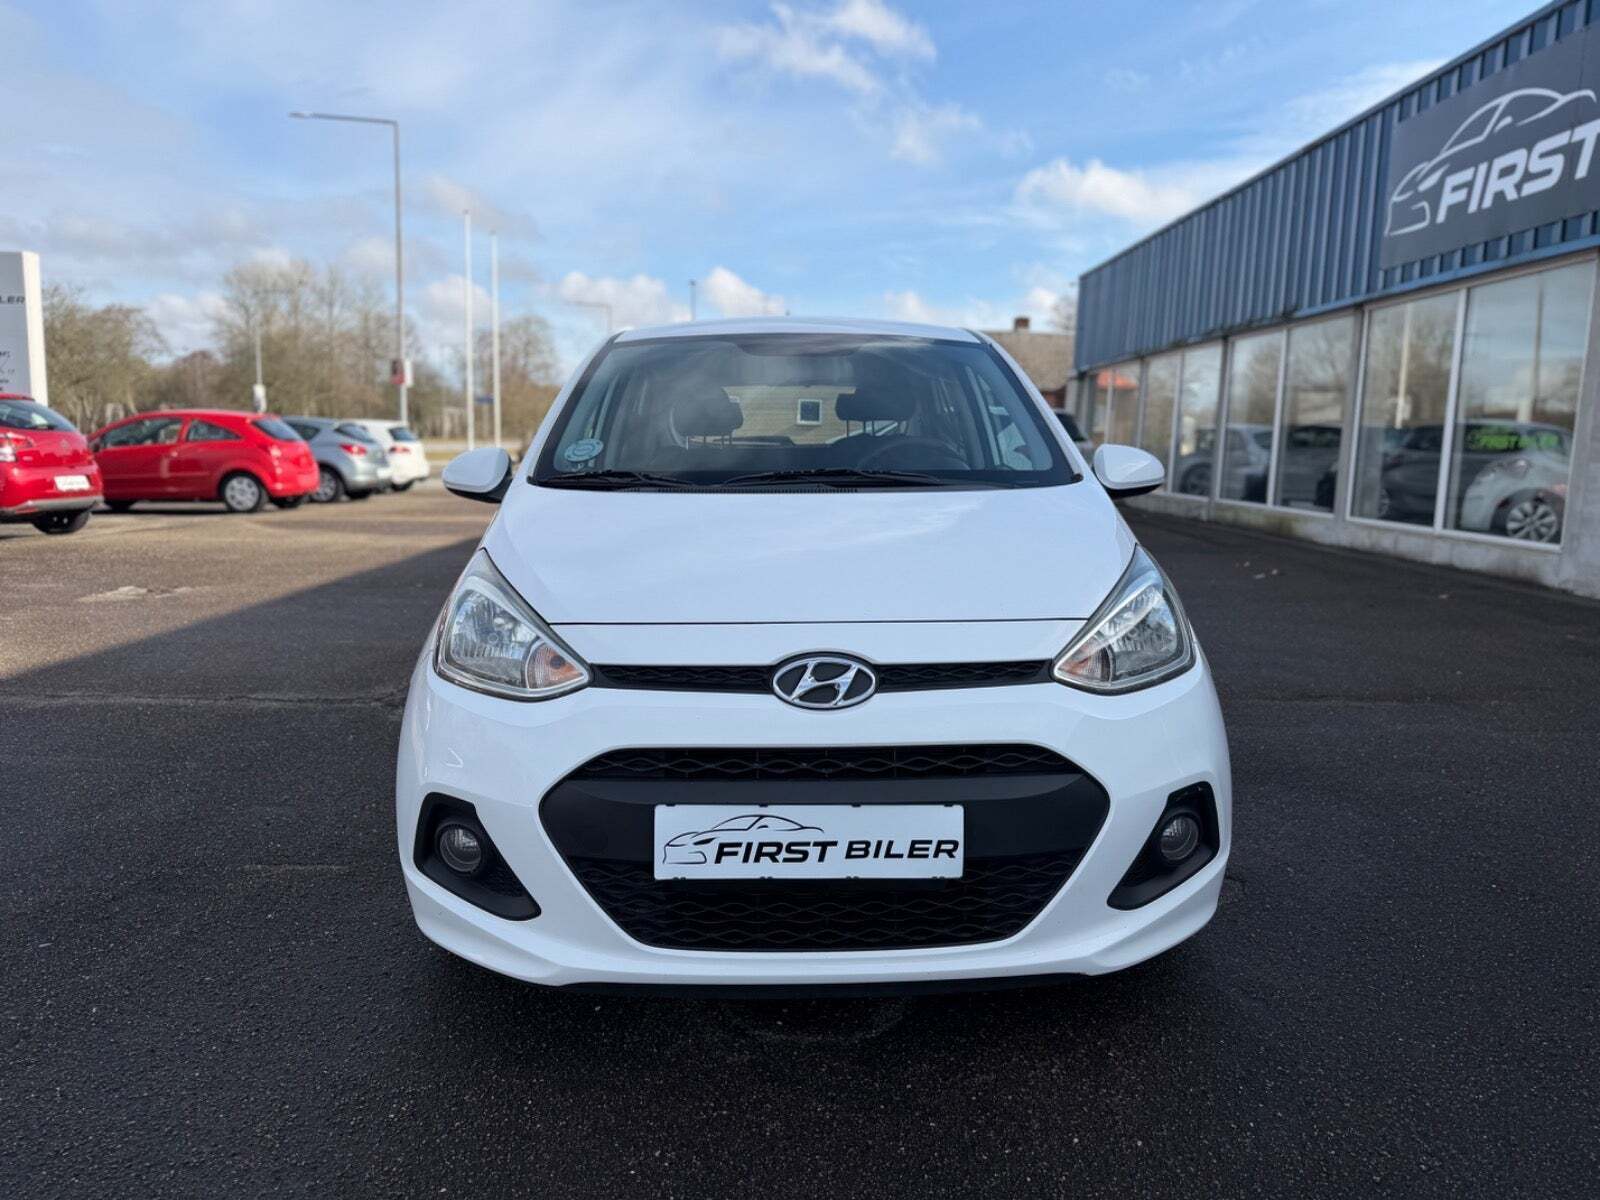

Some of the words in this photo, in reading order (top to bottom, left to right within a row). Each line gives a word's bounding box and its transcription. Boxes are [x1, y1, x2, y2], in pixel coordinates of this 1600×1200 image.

[1435, 118, 1600, 224] FIRST
[714, 840, 838, 864] FIRST
[845, 839, 959, 859] BILER
